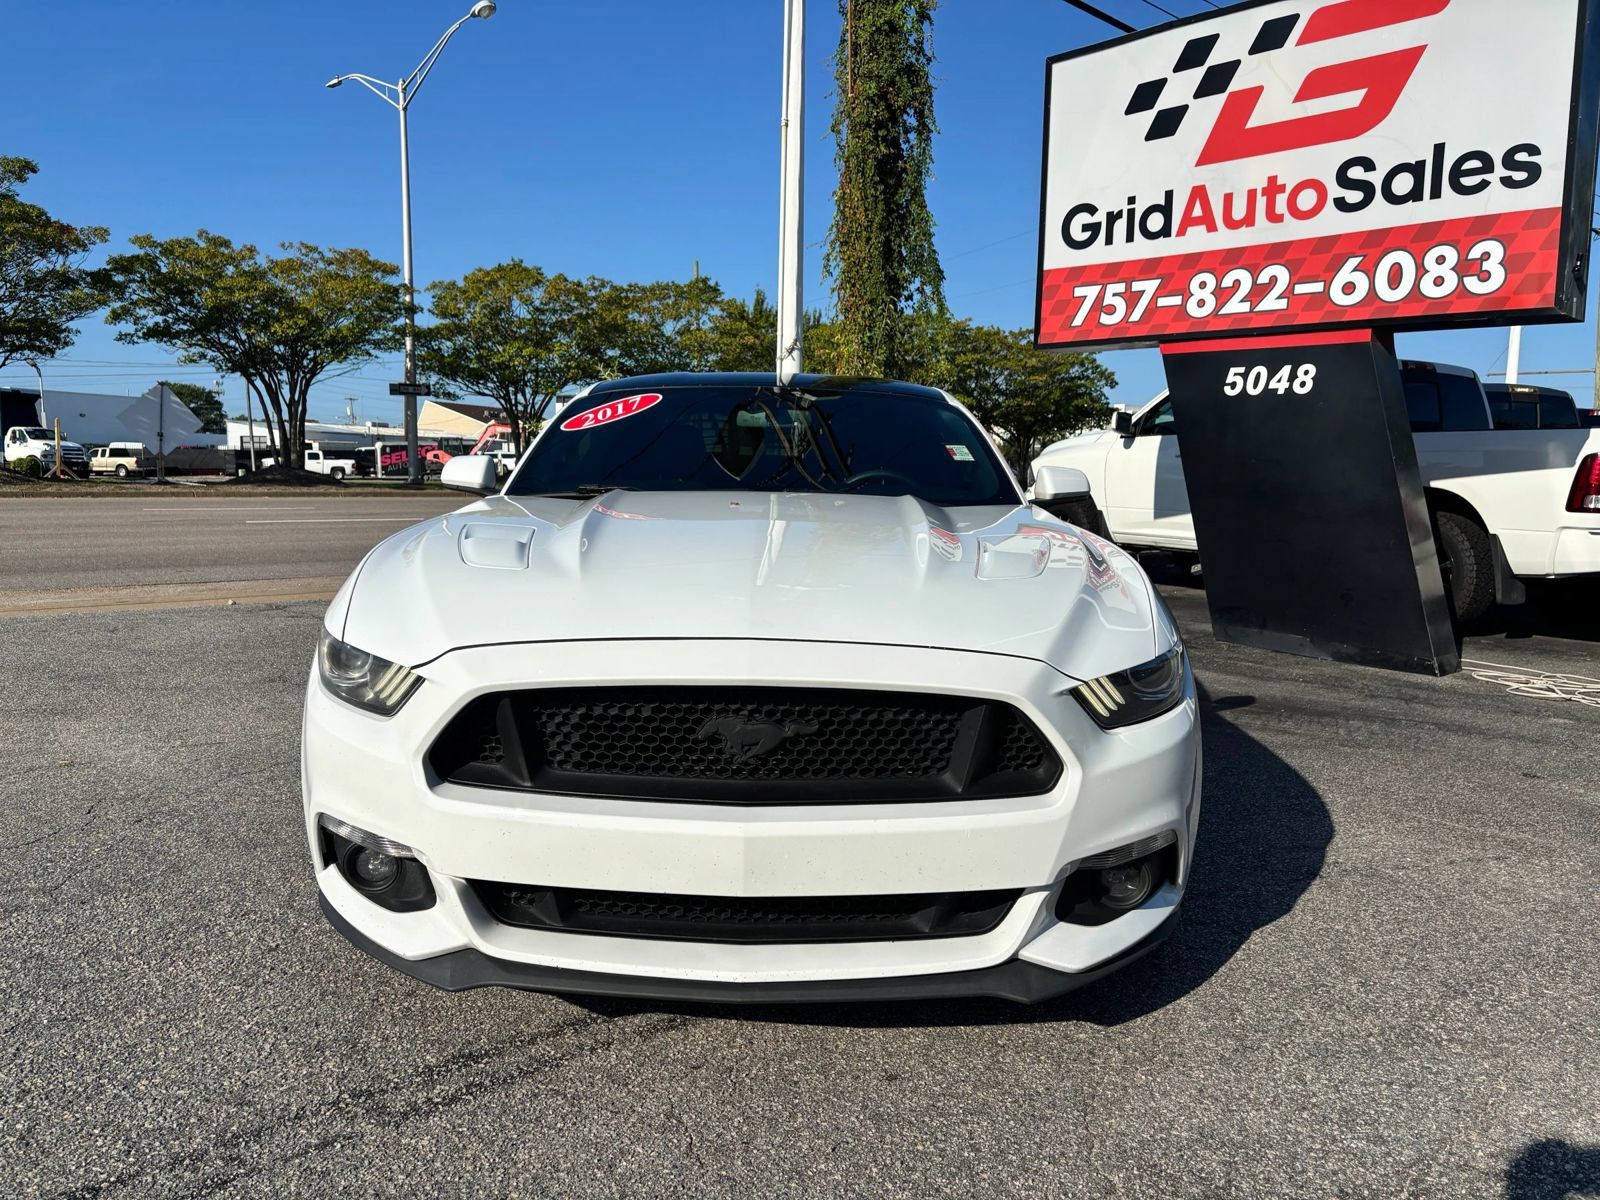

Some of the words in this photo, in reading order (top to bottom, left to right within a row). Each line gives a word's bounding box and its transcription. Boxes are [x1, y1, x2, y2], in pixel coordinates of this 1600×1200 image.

[1070, 238, 1508, 327] 757-822-6083
[1223, 363, 1317, 396] 5048
[581, 396, 642, 428] 2017
